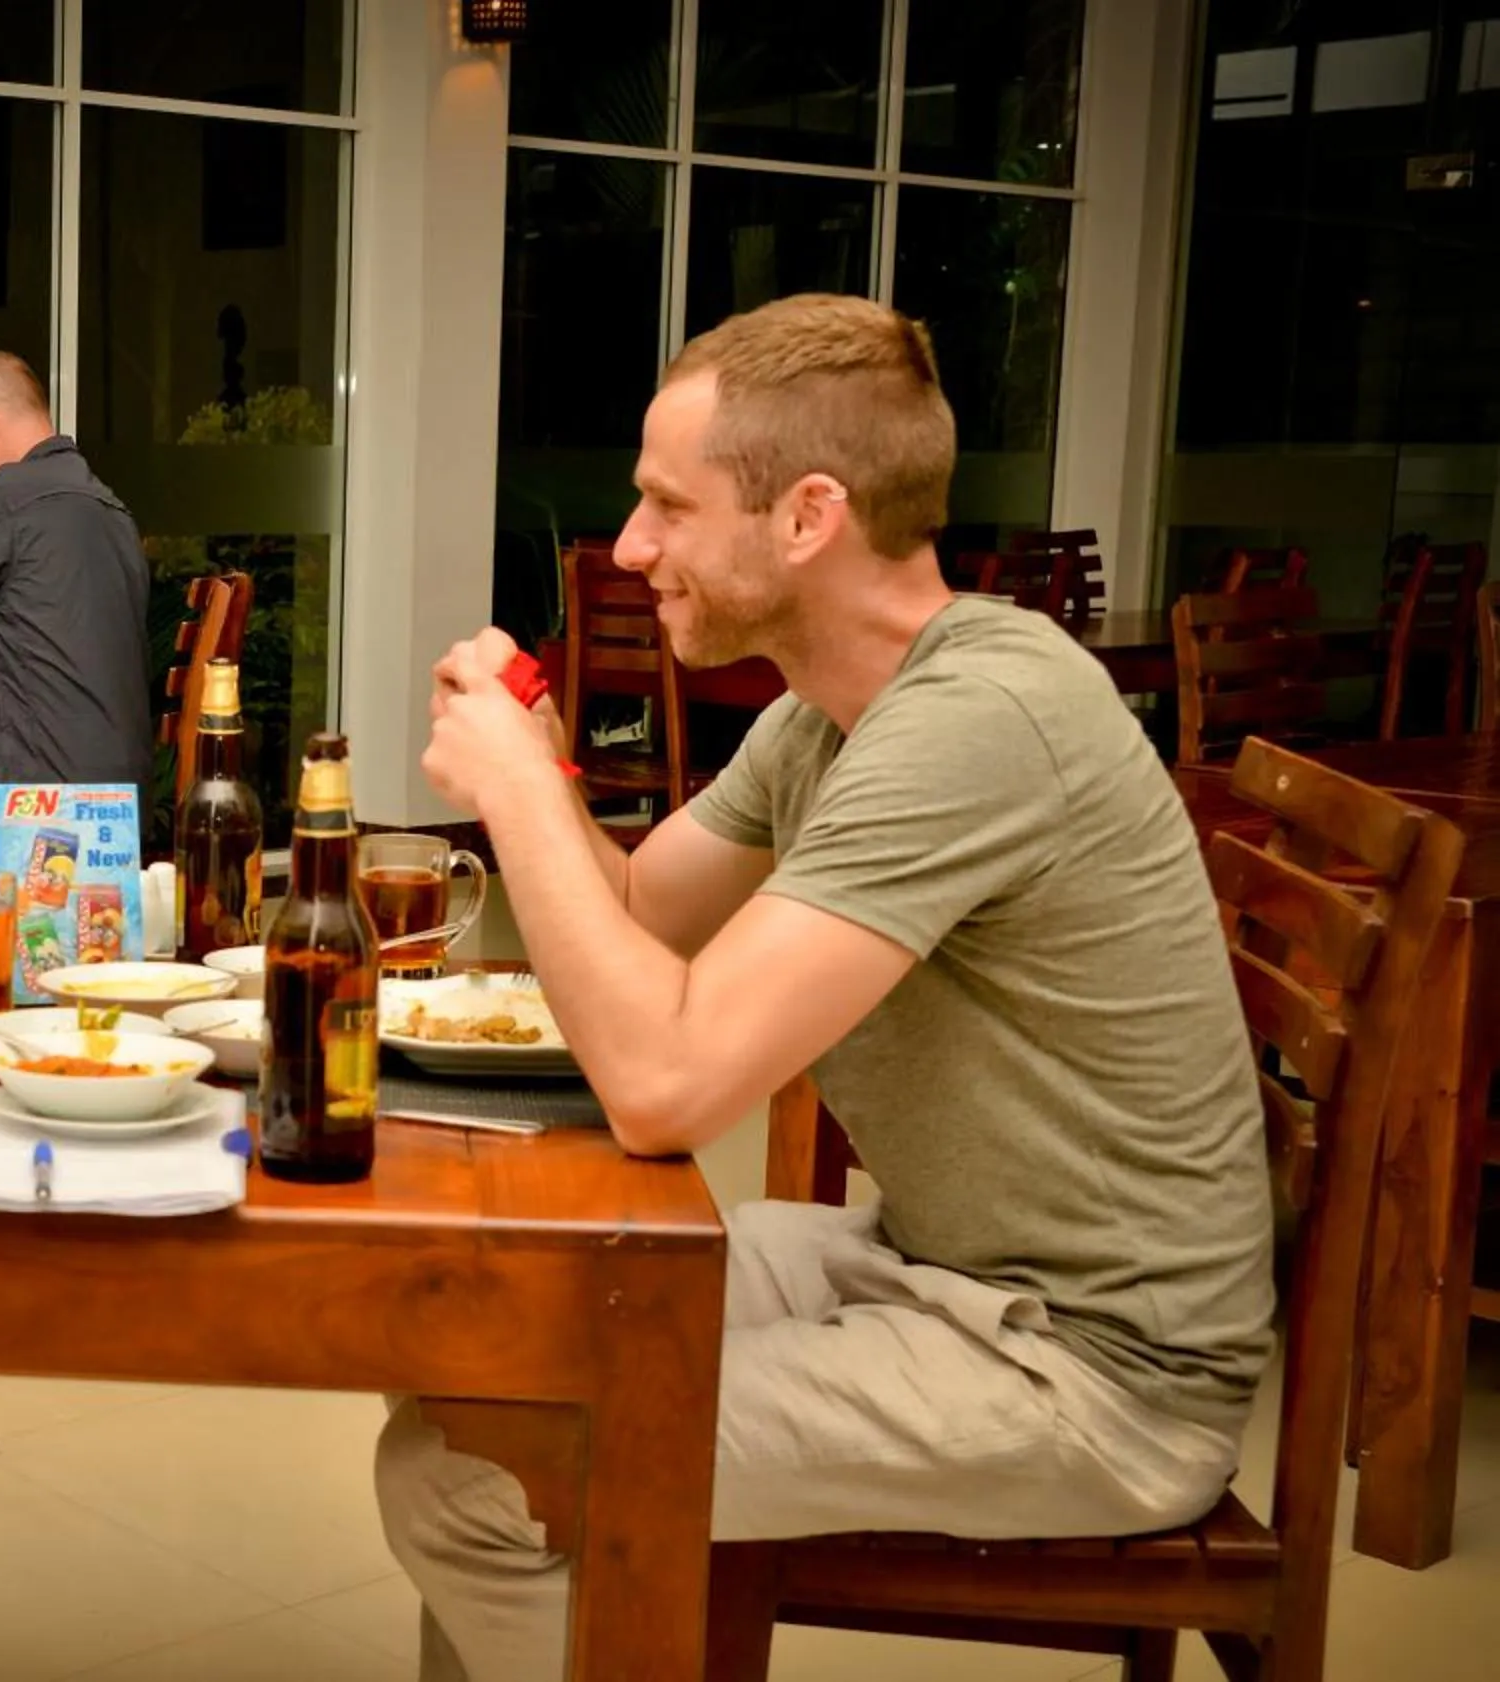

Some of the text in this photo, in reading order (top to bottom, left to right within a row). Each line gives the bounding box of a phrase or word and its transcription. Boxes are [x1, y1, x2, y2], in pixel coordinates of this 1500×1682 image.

[75, 802, 133, 819] Fresh
[98, 826, 112, 843] &
[87, 850, 133, 867] New
